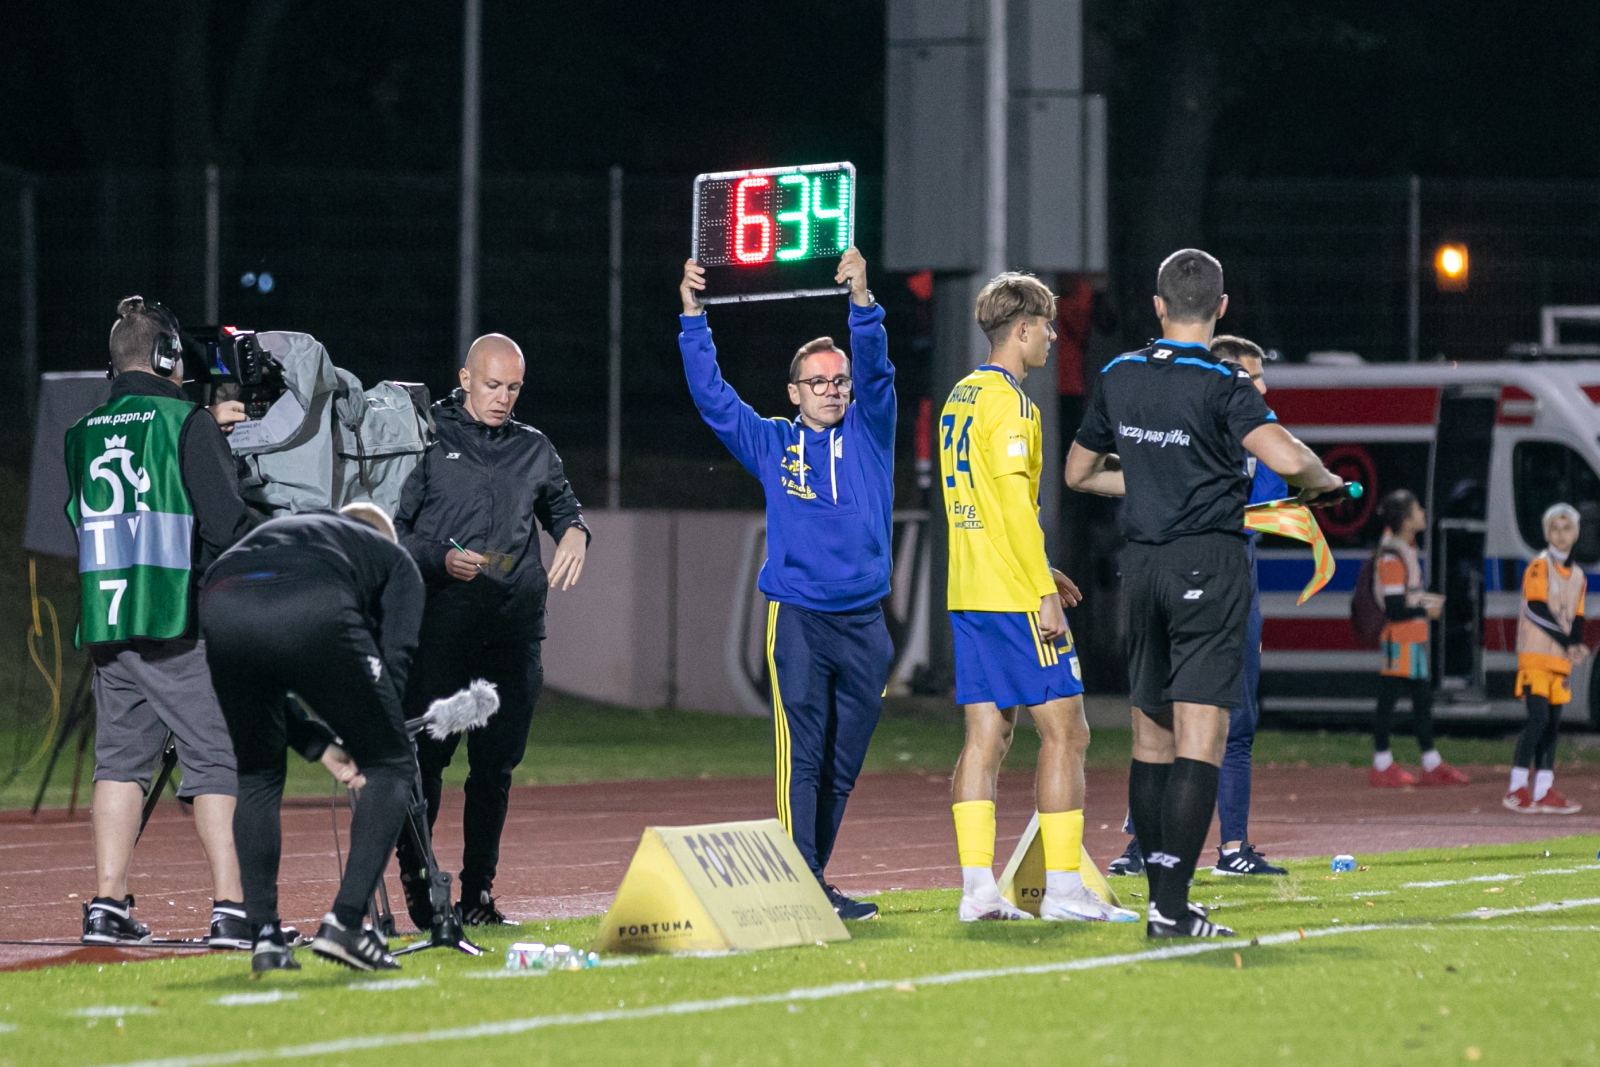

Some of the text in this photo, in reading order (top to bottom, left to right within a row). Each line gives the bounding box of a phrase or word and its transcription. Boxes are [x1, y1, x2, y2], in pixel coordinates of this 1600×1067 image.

[735, 173, 850, 262] 6 34
[87, 409, 156, 427] www.pzpn.pl
[1143, 429, 1165, 443] nas
[1161, 429, 1190, 448] piłka
[99, 579, 128, 625] 7
[683, 830, 800, 889] FORTUNA
[618, 919, 693, 937] FORTUNA
